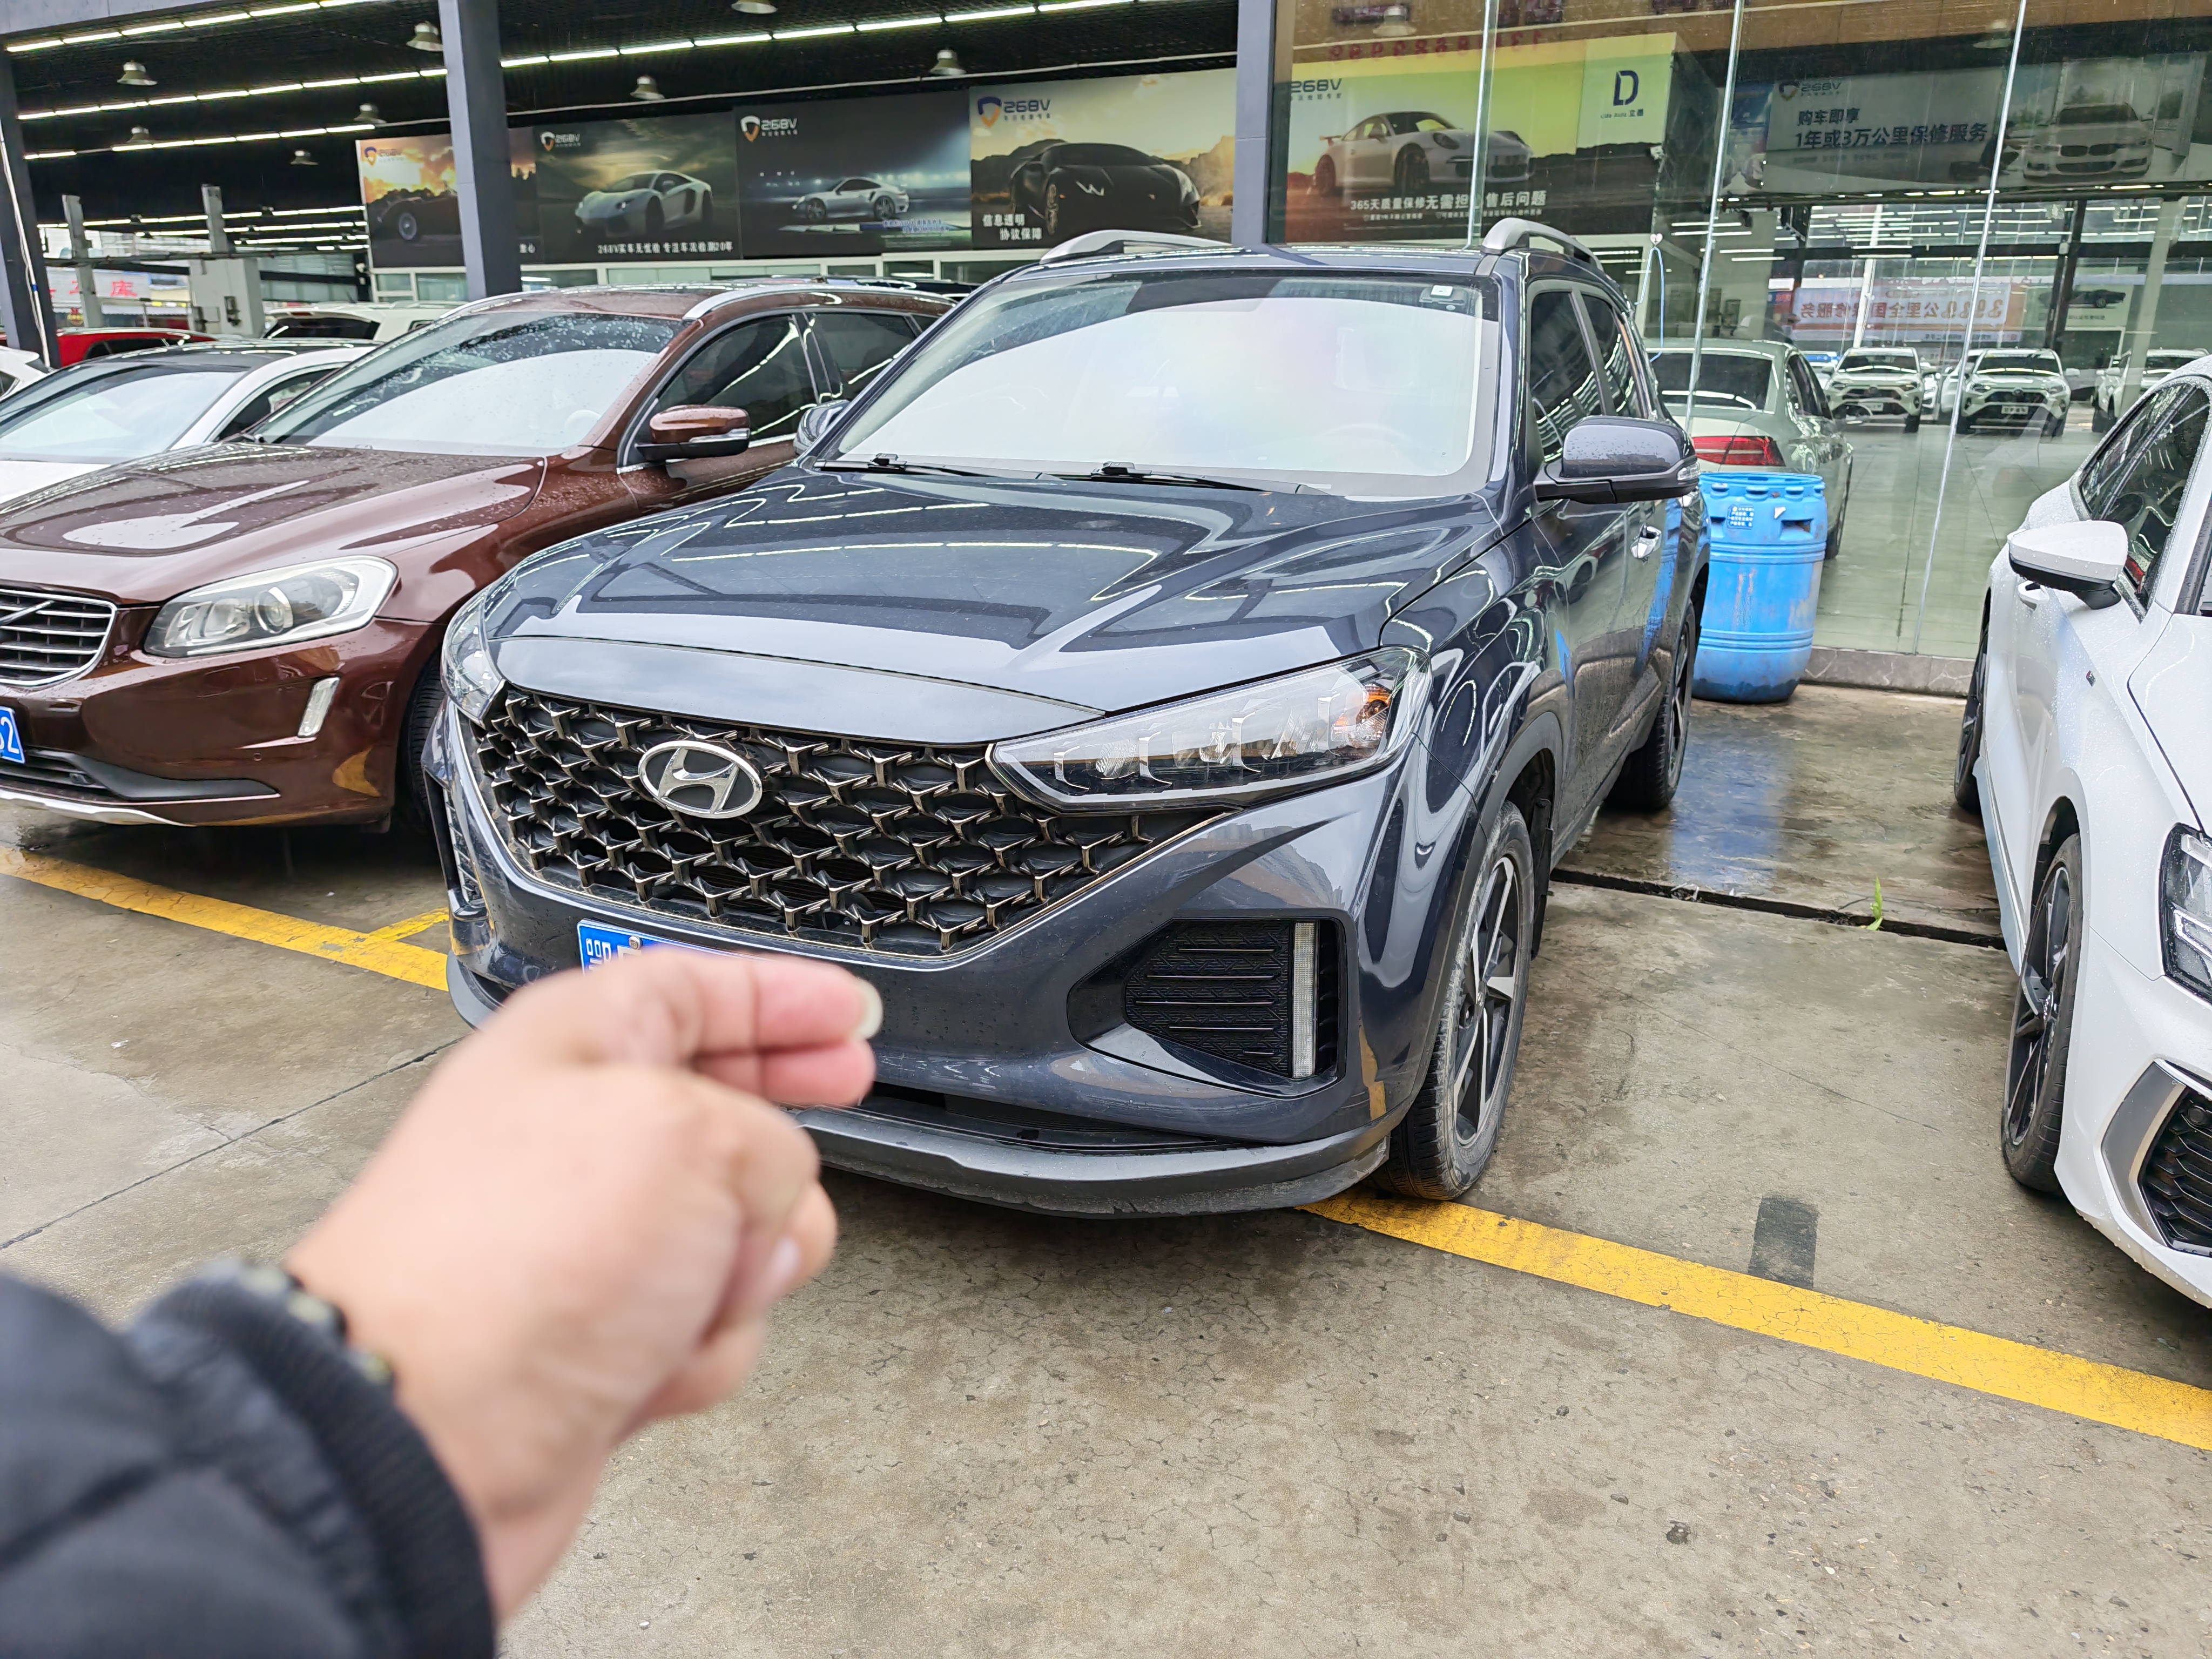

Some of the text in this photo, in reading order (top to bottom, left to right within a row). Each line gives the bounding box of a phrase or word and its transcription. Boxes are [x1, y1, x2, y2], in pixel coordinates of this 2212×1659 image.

[1004, 99, 1051, 113] 268V
[1797, 108, 1860, 126] 购车即享
[760, 118, 798, 131] 268V
[1795, 123, 1988, 148] 1年或3万公里保修服务
[982, 214, 1025, 227] 信息透明
[1000, 227, 1042, 240] 协议保障
